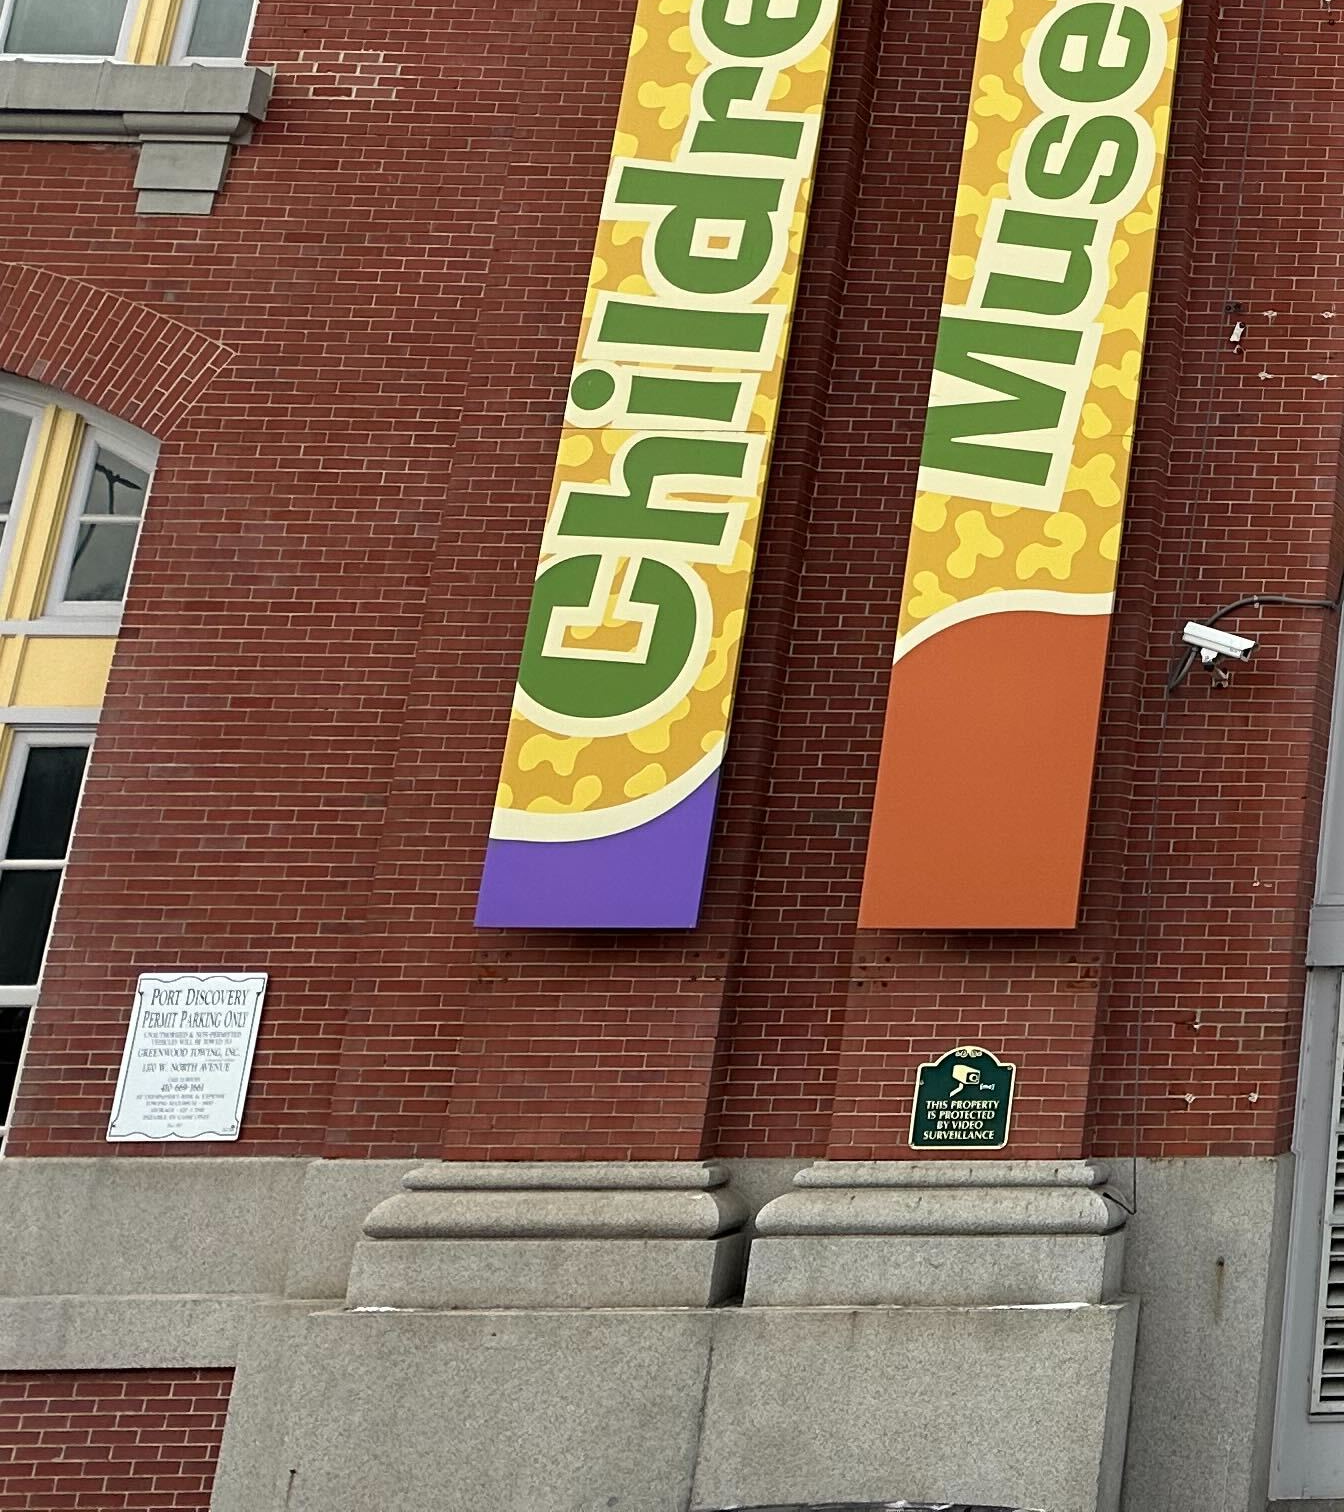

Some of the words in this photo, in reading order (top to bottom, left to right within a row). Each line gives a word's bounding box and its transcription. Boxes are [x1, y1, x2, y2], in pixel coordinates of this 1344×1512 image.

[151, 988, 182, 1006] PORT
[185, 988, 250, 1006] DISCOVERY
[142, 1010, 178, 1029] PERMIT
[179, 1010, 222, 1029] PARKING
[224, 1009, 249, 1028] ONLY
[926, 1100, 948, 1110] THIS
[950, 1100, 1000, 1110] PROPERTY
[927, 1110, 937, 1120] IS
[939, 1110, 995, 1120] PROTECTED
[936, 1120, 949, 1130] BY
[951, 1120, 984, 1130] VIDEO
[923, 1130, 995, 1140] SURVEILLANCE
